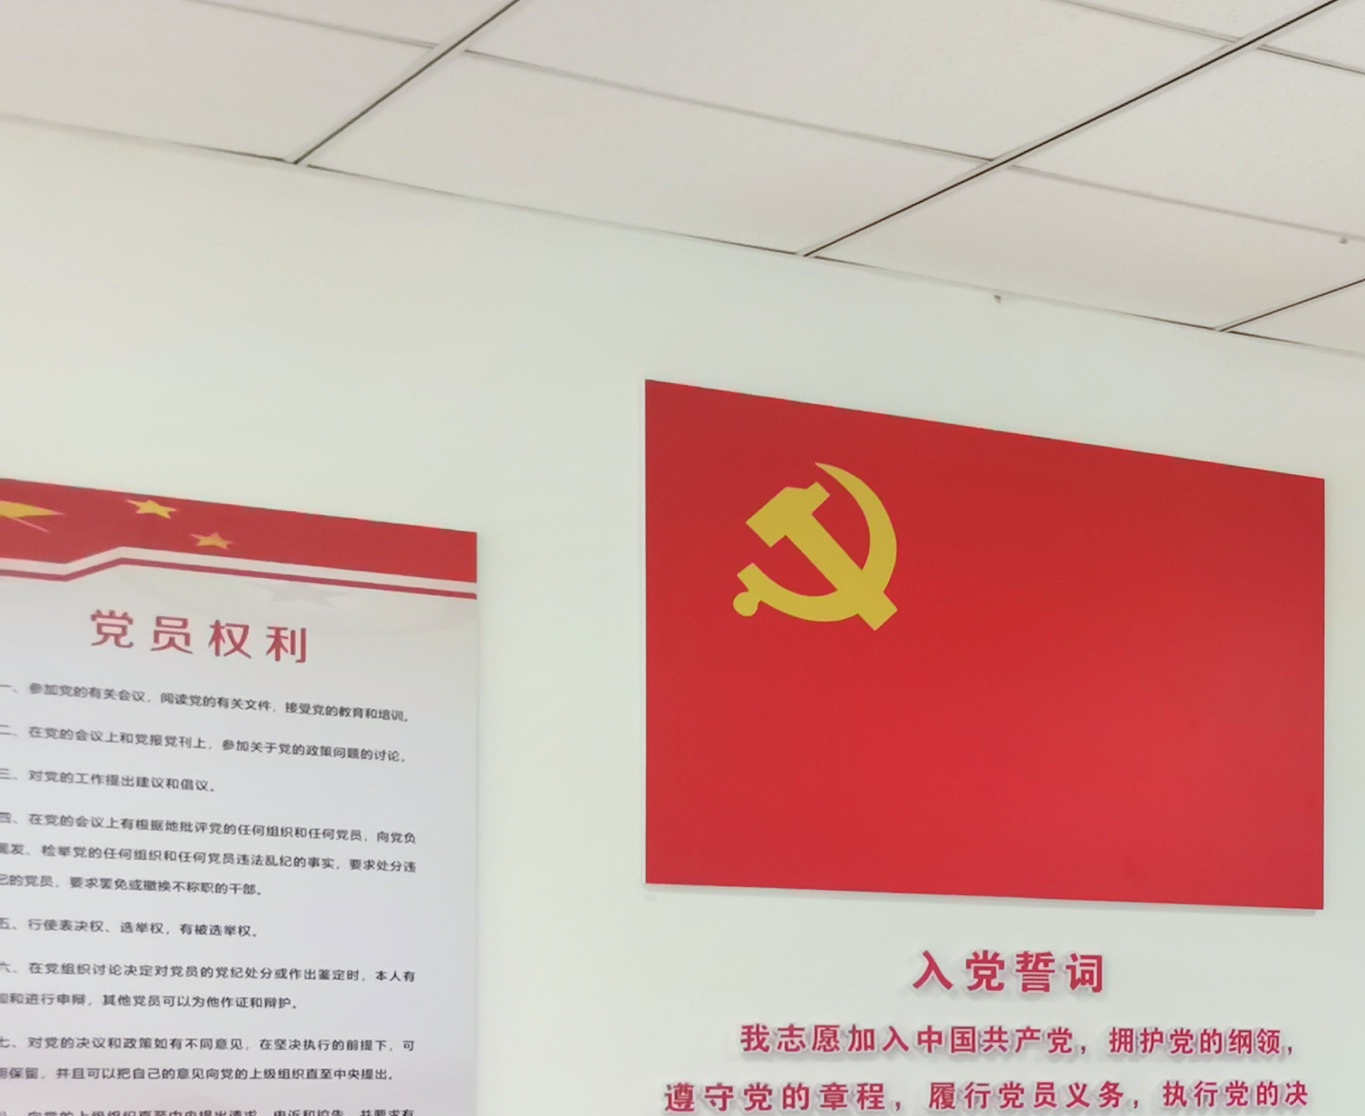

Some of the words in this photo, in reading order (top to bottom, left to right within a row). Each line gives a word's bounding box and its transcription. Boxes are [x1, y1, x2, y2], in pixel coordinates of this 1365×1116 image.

[90, 608, 309, 664] 党员权利
[912, 949, 1104, 994] 入党誓词
[740, 1024, 1296, 1056] 我志愿加入中国共产党，拥护党的纲领，
[663, 1080, 1309, 1113] 遵守党的章程，履行党员义务，执行党的决
